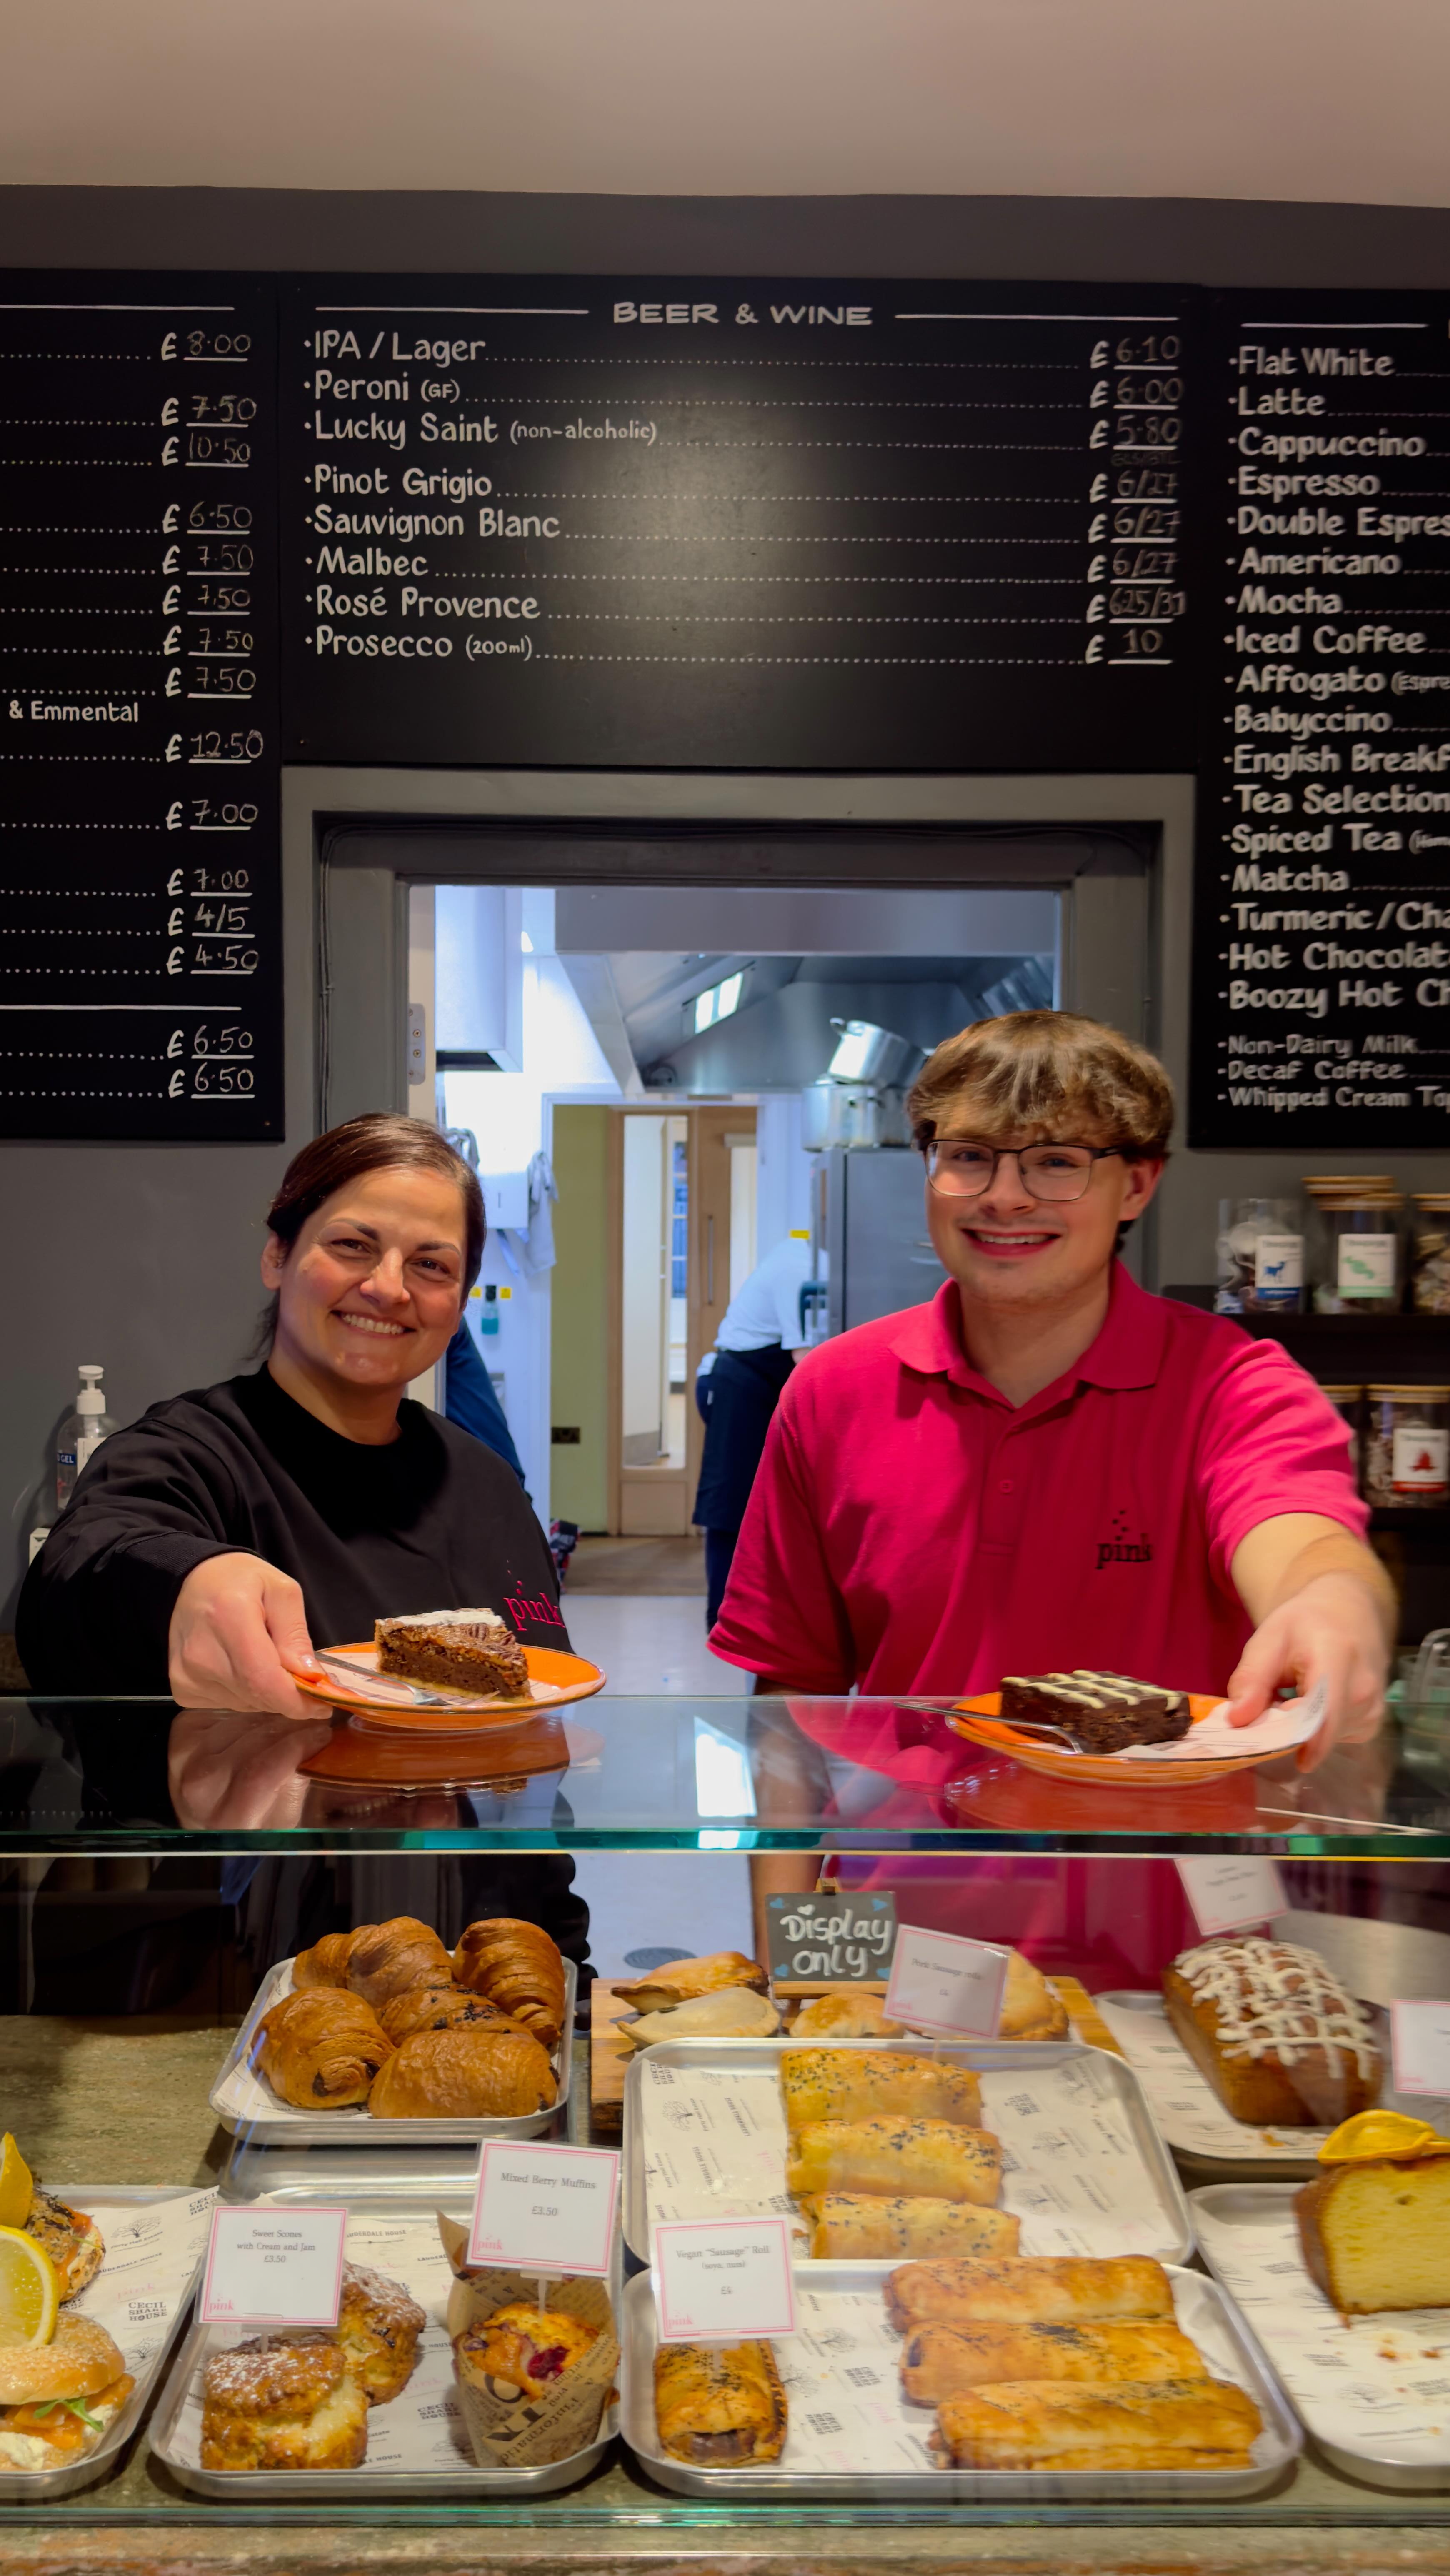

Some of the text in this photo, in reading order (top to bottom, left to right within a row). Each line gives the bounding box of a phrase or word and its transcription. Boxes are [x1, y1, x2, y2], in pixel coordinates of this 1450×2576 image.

[614, 302, 873, 326] BEER & WINE
[315, 330, 361, 359] IPA
[392, 332, 486, 368] Lager
[1238, 345, 1395, 376] Flat White
[315, 370, 460, 403] Peroni (GF)
[1238, 386, 1326, 416] Latte
[315, 410, 658, 450] Lucky Saint (non-alcoholic)
[1238, 426, 1427, 463] Cappuccino
[315, 464, 492, 503] Pinot Grigio
[1238, 465, 1381, 503] Espresso
[314, 505, 560, 543] Sauvignon Blanc
[1238, 505, 1347, 536] Double
[316, 546, 429, 577] Malbec
[1238, 546, 1402, 575] Americano
[316, 584, 541, 620] Rosé Provence
[1236, 585, 1343, 614] Mocha
[316, 625, 533, 662] Prosecco (200ml)
[1236, 625, 1428, 654] Iced Coffee
[1235, 664, 1387, 701] Affogato
[9, 700, 139, 723] & Emmental
[1234, 704, 1392, 741] Babyccino
[1234, 743, 1450, 780] English Breakf
[1233, 783, 1450, 815] Tea Selection
[1231, 823, 1334, 860] Spiced
[1341, 823, 1403, 851] Tea
[1232, 864, 1350, 892] Matcha
[1229, 941, 1450, 971] Hot Chocolat
[1230, 980, 1329, 1019] Boozy
[1339, 980, 1404, 1007] Hot
[1228, 1033, 1418, 1060] Non-Dairy Milk
[1228, 1060, 1409, 1080] Decaf Coffee
[1229, 1086, 1330, 1113] Whipped
[1335, 1086, 1412, 1107] Cream
[60, 1455, 74, 1463] GEL
[503, 1588, 566, 1631] pink
[780, 1908, 892, 1955] Display
[792, 1945, 868, 1977] only
[501, 2172, 596, 2189] Mixed Berry Muffins
[531, 2206, 558, 2216] £3.50
[252, 2229, 302, 2238] Sweet Scones
[300, 2243, 315, 2252] Jam
[98, 2261, 138, 2273] AUDERDALE
[263, 2255, 286, 2263] £3.50
[676, 2249, 702, 2260] Vegan
[752, 2245, 770, 2254] Roll
[128, 2301, 167, 2310] CECIL
[129, 2311, 167, 2322] HOUSE
[209, 2296, 234, 2314] pink
